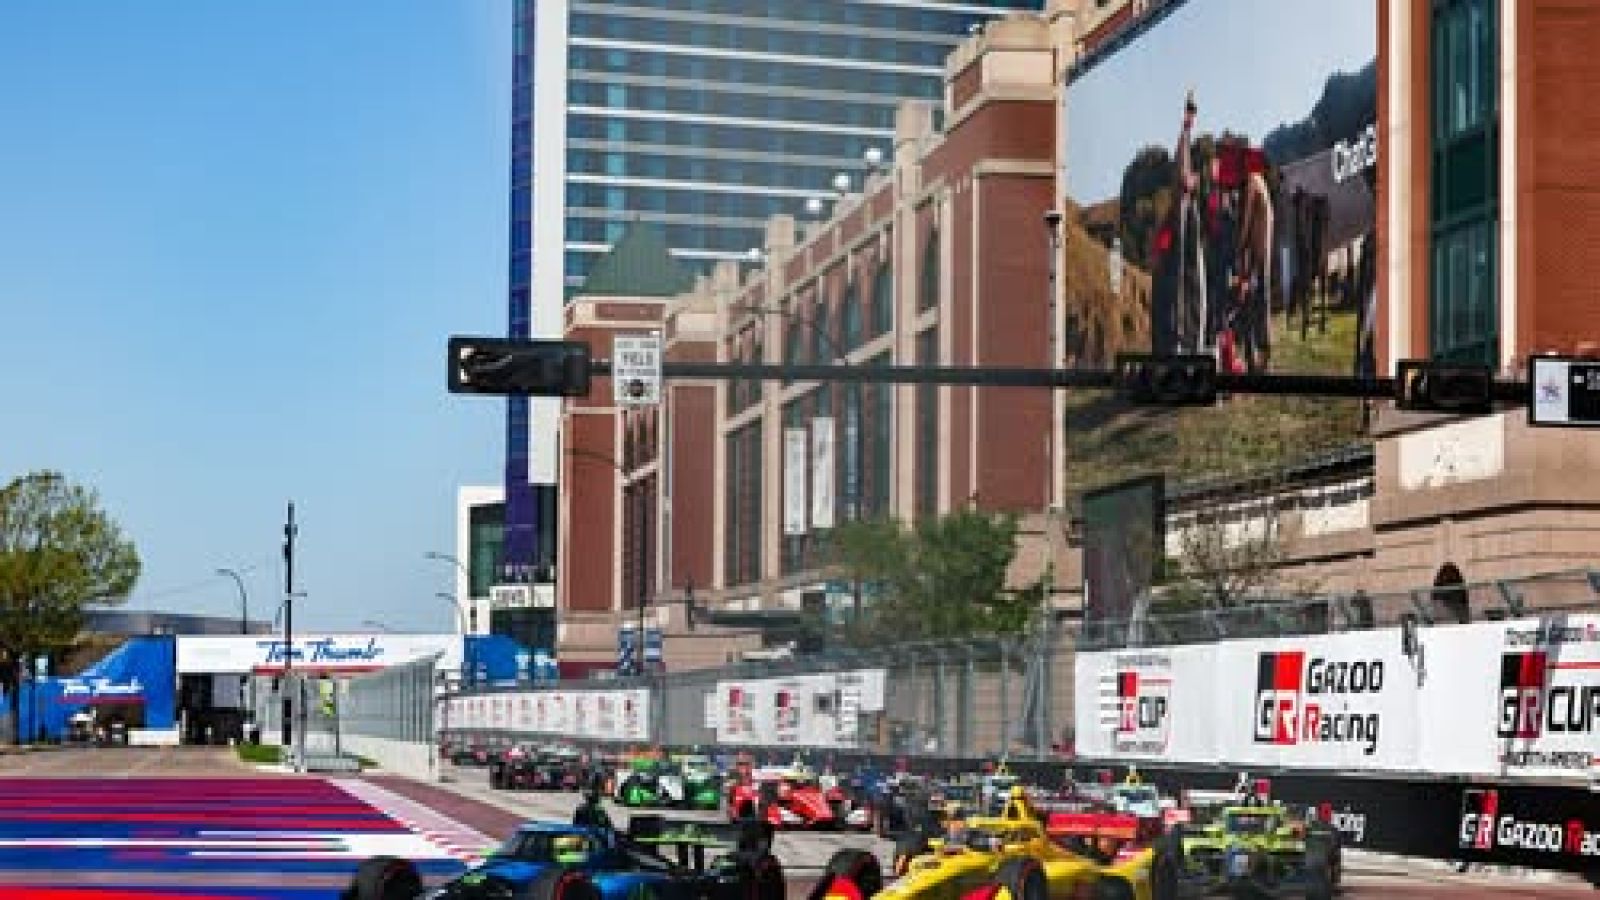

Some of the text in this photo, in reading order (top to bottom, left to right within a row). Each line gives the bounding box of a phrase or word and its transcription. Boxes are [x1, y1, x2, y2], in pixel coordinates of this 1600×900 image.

[304, 638, 384, 662] Thumb
[1307, 658, 1383, 694] GAZOO
[1138, 696, 1166, 728] CUP
[1255, 690, 1299, 744] GR
[1547, 686, 1600, 732] CUP
[1303, 702, 1380, 755] Racing
[1497, 814, 1563, 852] GAZOO
